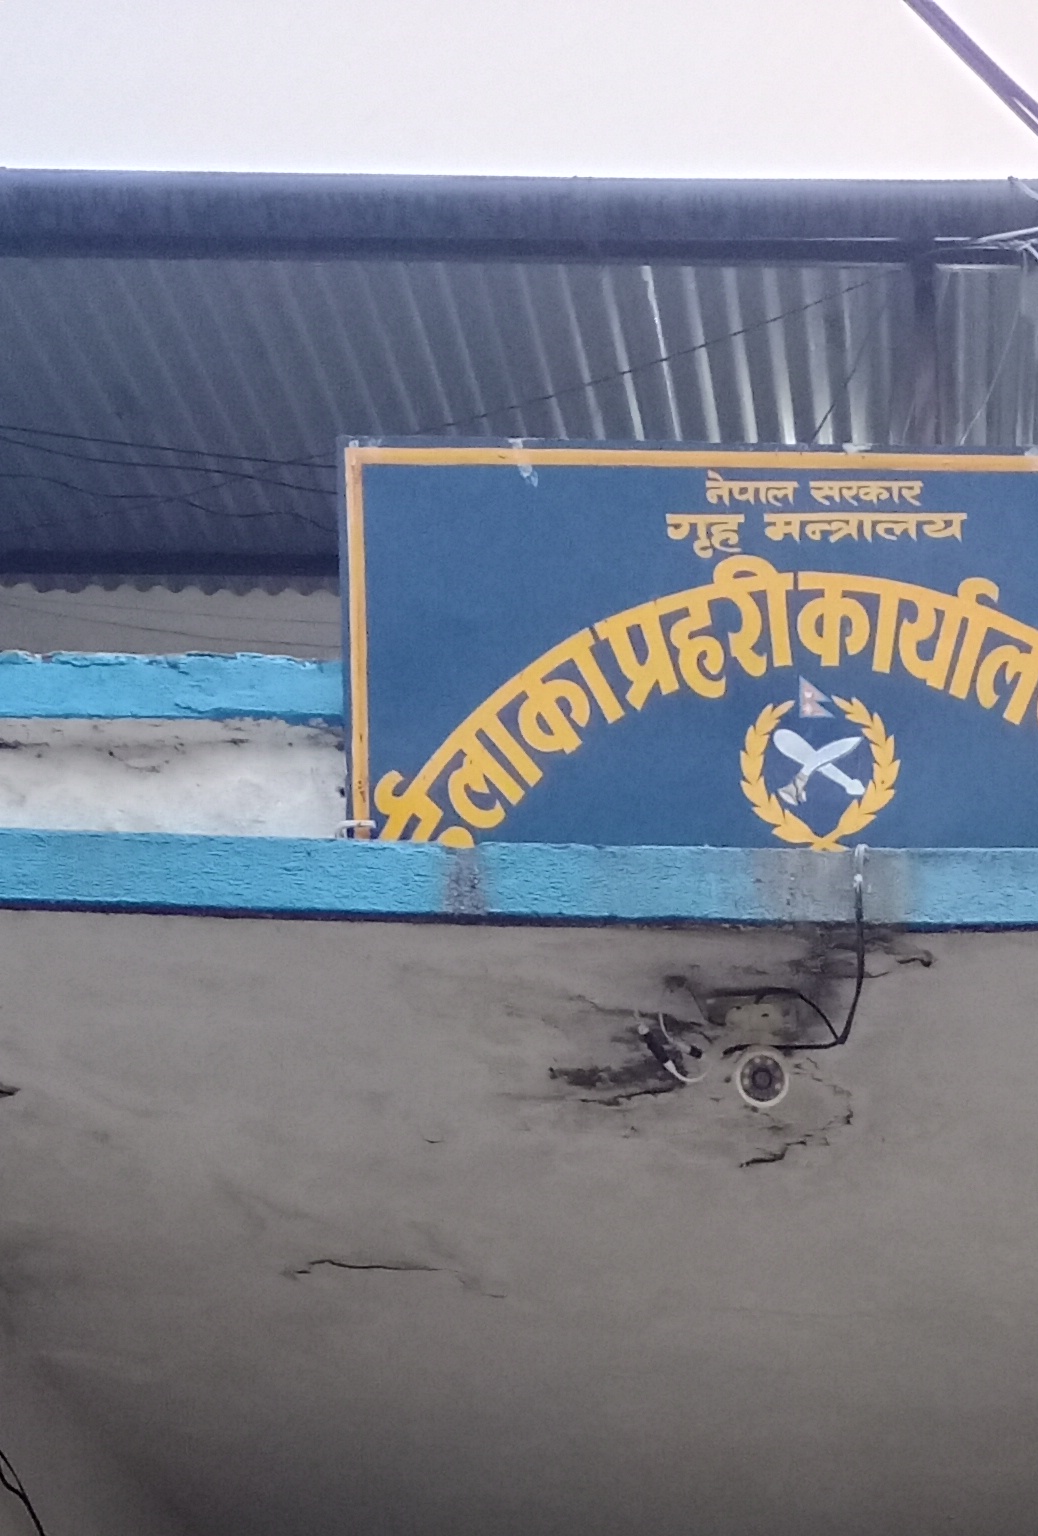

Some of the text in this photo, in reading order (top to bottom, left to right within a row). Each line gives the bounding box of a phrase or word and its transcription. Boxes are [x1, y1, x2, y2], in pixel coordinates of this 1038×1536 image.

[706, 470, 923, 506] नेपाल सरकार
[666, 511, 967, 558] गृह मन्त्रालय
[600, 555, 794, 708] प्रहरी
